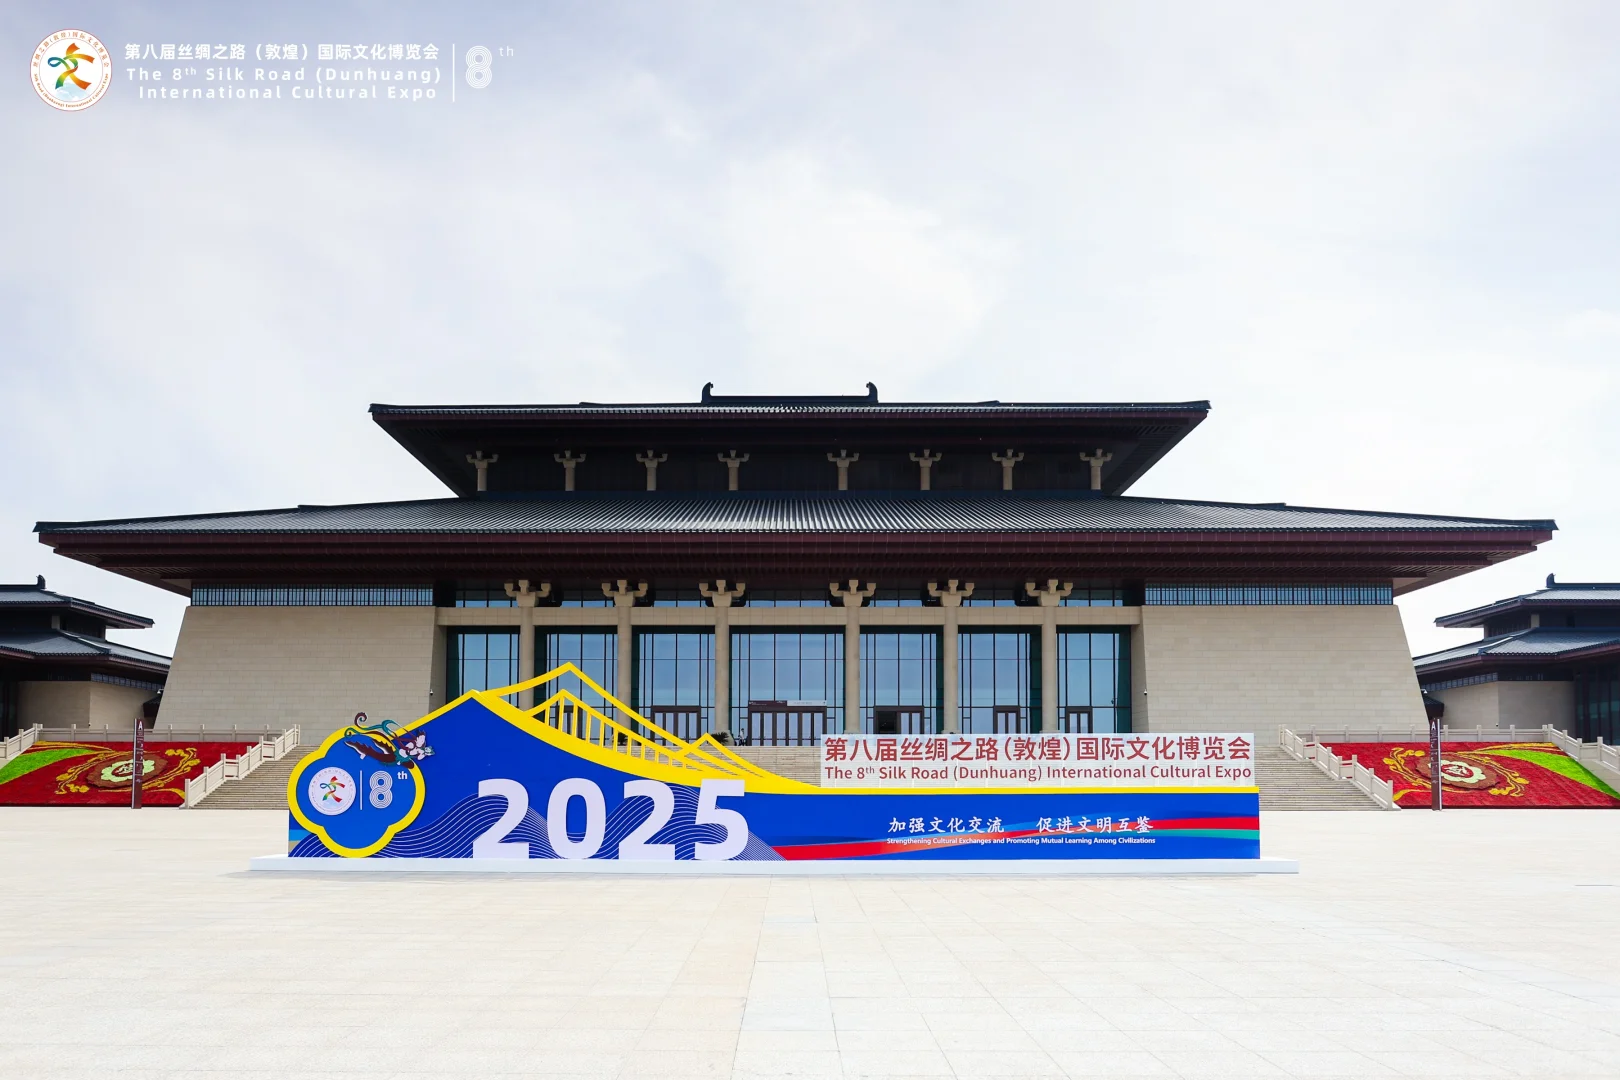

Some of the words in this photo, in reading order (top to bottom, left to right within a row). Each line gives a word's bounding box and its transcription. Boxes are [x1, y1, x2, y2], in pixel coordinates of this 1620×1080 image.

[138, 720, 143, 730] A
[1431, 721, 1436, 730] A
[824, 766, 853, 779] The
[856, 765, 875, 779] 8th
[879, 765, 906, 779] Silk
[911, 766, 949, 779] Road
[953, 765, 1042, 782] (Dunhuang)
[1047, 765, 1146, 779] International
[1150, 764, 1211, 779] Cultural
[1215, 766, 1252, 781] Expo
[473, 778, 749, 860] 2025
[887, 816, 1005, 833] 加强文化交流
[1036, 815, 1154, 834] 促进文明互鉴
[886, 837, 932, 845] Strengthening
[959, 837, 992, 845] Exchanges
[1006, 837, 1040, 845] Promoting
[1065, 837, 1092, 845] Learning
[1093, 837, 1117, 845] Among
